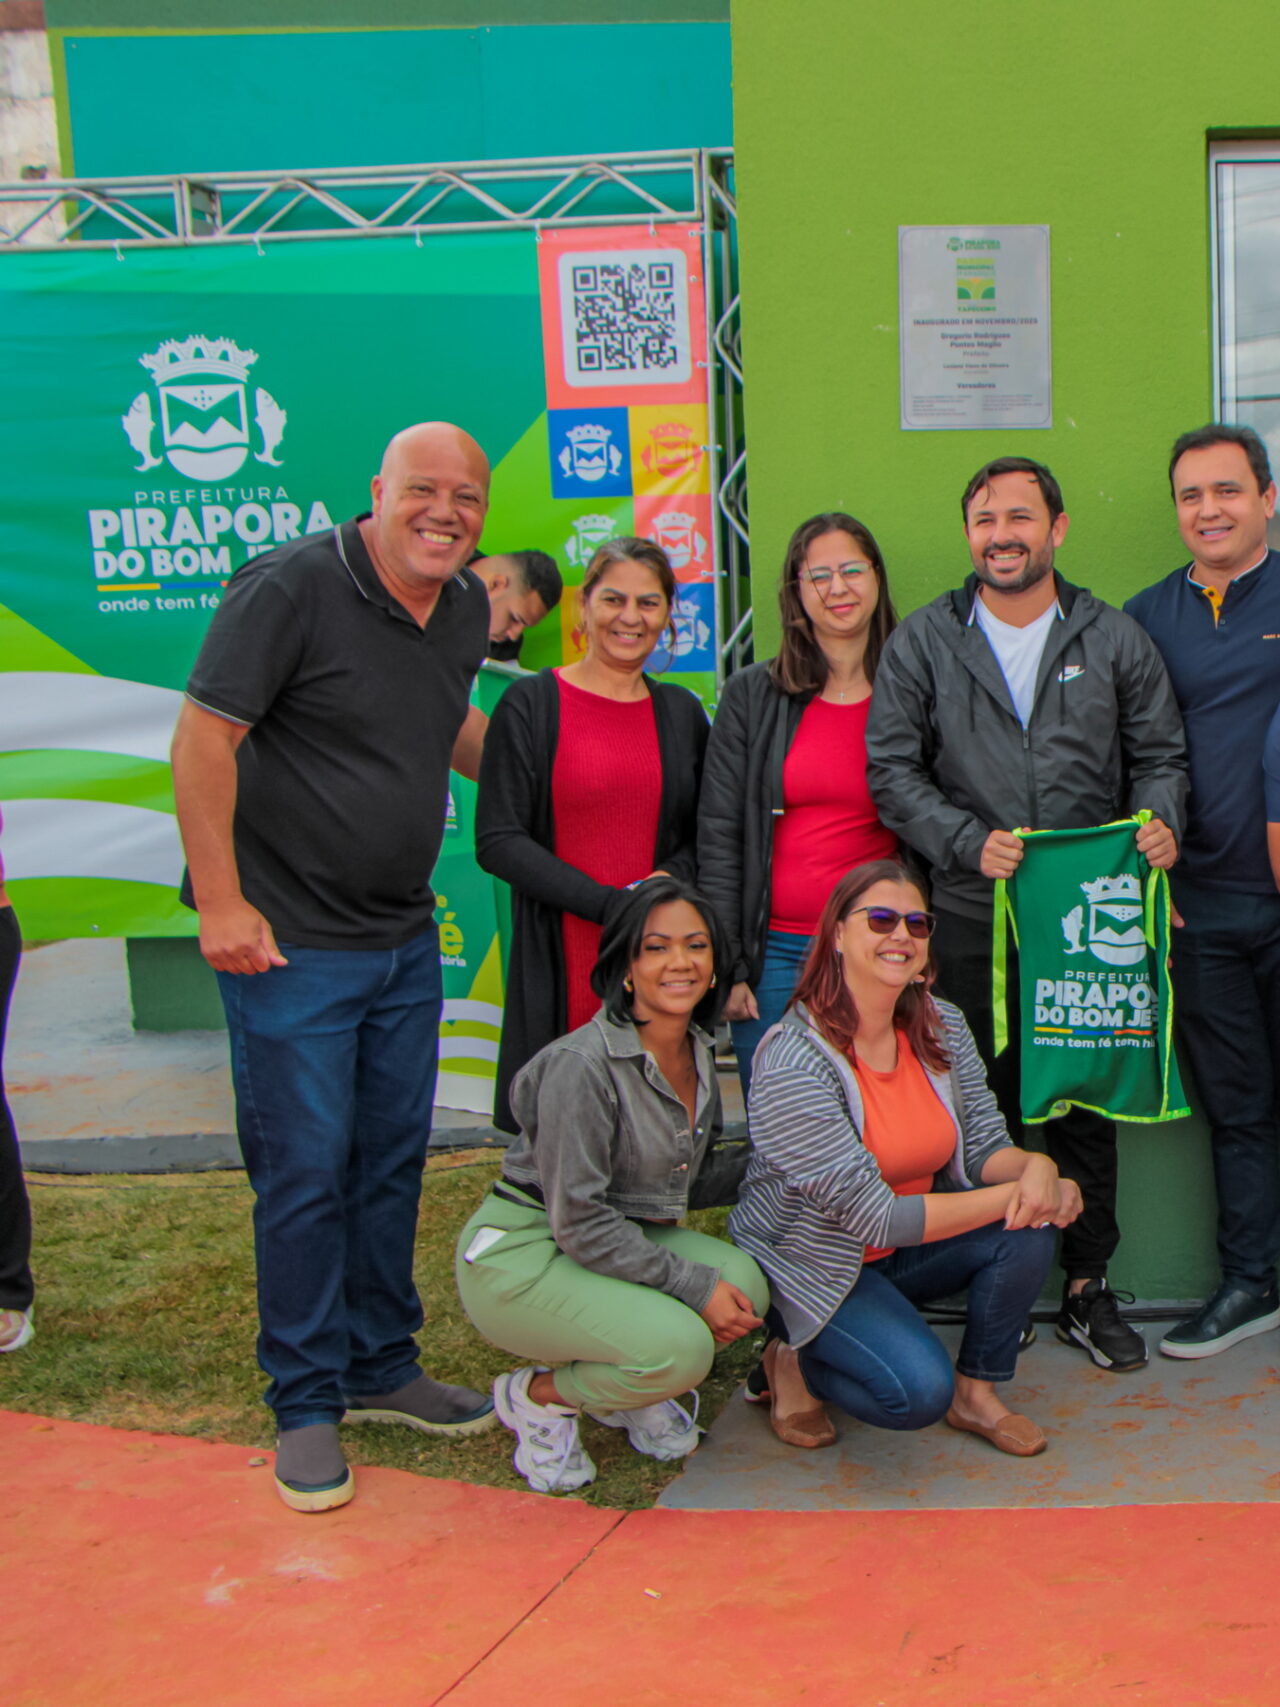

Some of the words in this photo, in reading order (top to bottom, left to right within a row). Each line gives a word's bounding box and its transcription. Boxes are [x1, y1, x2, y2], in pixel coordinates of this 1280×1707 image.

[134, 486, 289, 505] PREFEITURA
[88, 501, 334, 549] PIRAPORA
[93, 548, 146, 579] DO
[150, 546, 232, 577] BOM
[98, 597, 150, 613] onde
[155, 596, 195, 611] tem
[199, 593, 220, 609] fé
[1034, 1004, 1065, 1025] DO
[1068, 1006, 1123, 1027] BOM
[1033, 1036, 1064, 1047] onde
[1067, 1037, 1095, 1048] tem
[1098, 1037, 1112, 1048] fé
[1115, 1037, 1140, 1048] tem
